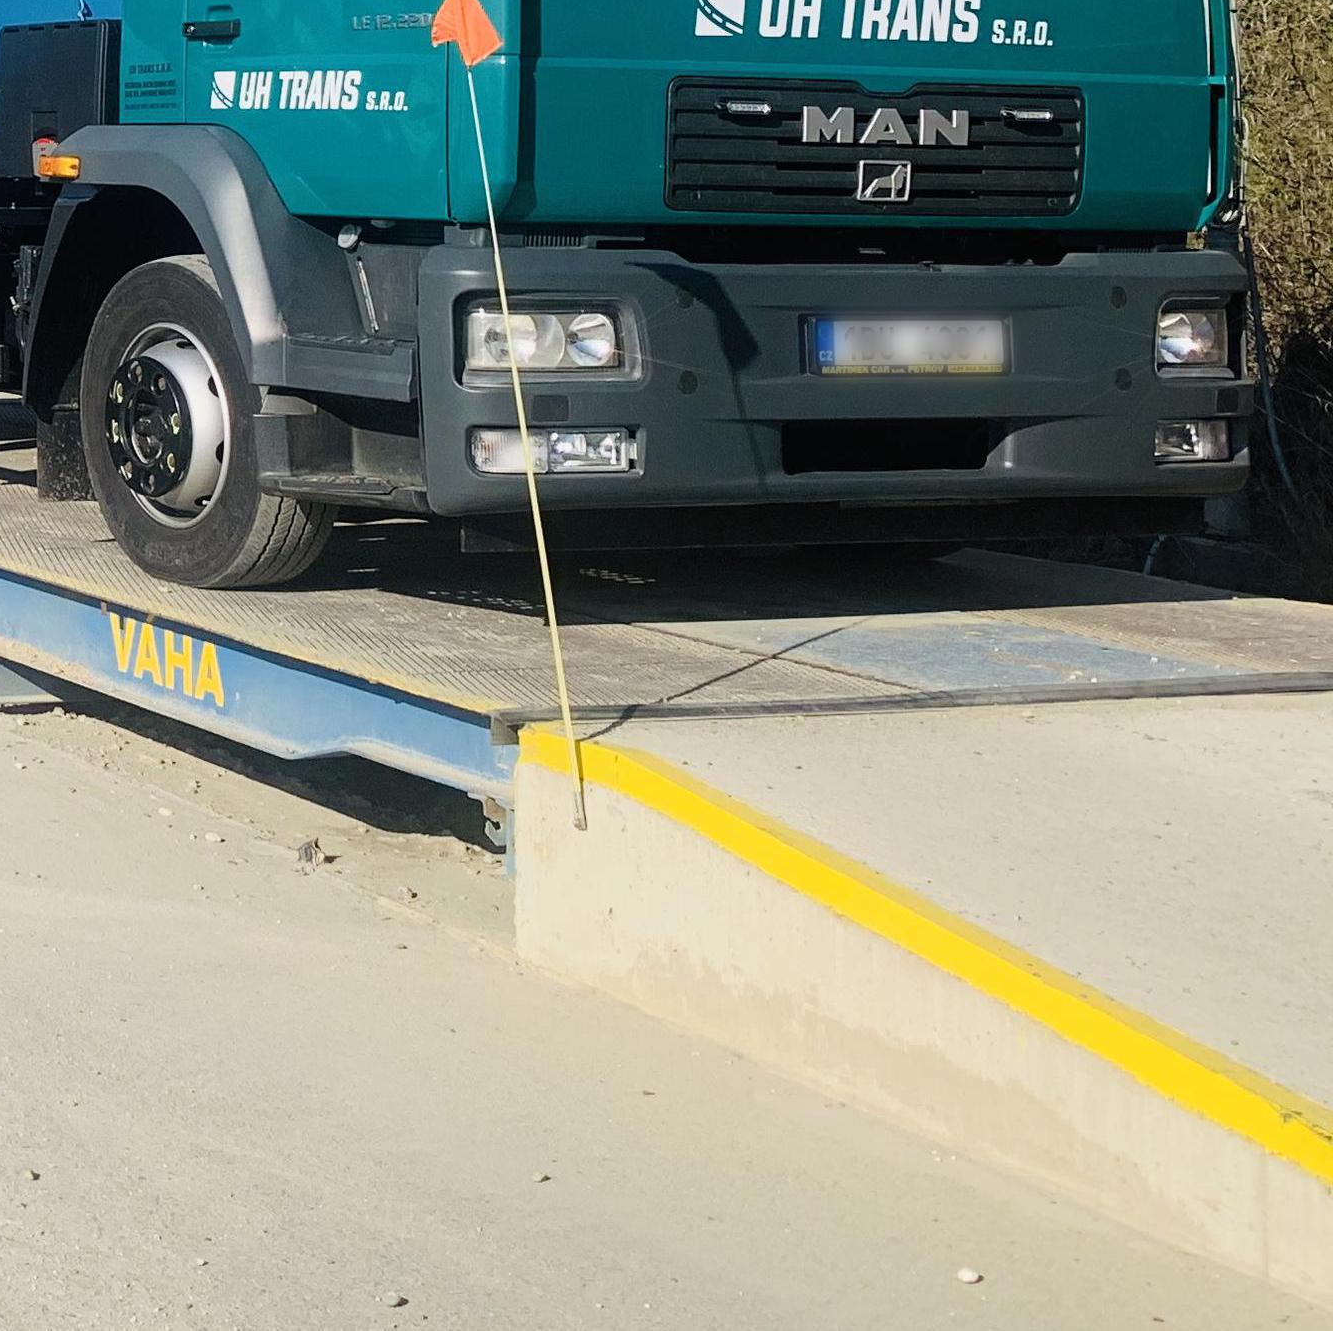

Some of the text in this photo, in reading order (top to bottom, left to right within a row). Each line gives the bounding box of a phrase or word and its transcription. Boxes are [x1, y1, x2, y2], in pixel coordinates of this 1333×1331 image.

[990, 18, 1055, 47] S.R.O.
[238, 70, 409, 112] UH TRANS S.R.O.
[801, 105, 970, 146] MAN
[819, 350, 833, 362] CZ
[871, 365, 890, 374] CAR
[109, 611, 225, 708] VAHA
